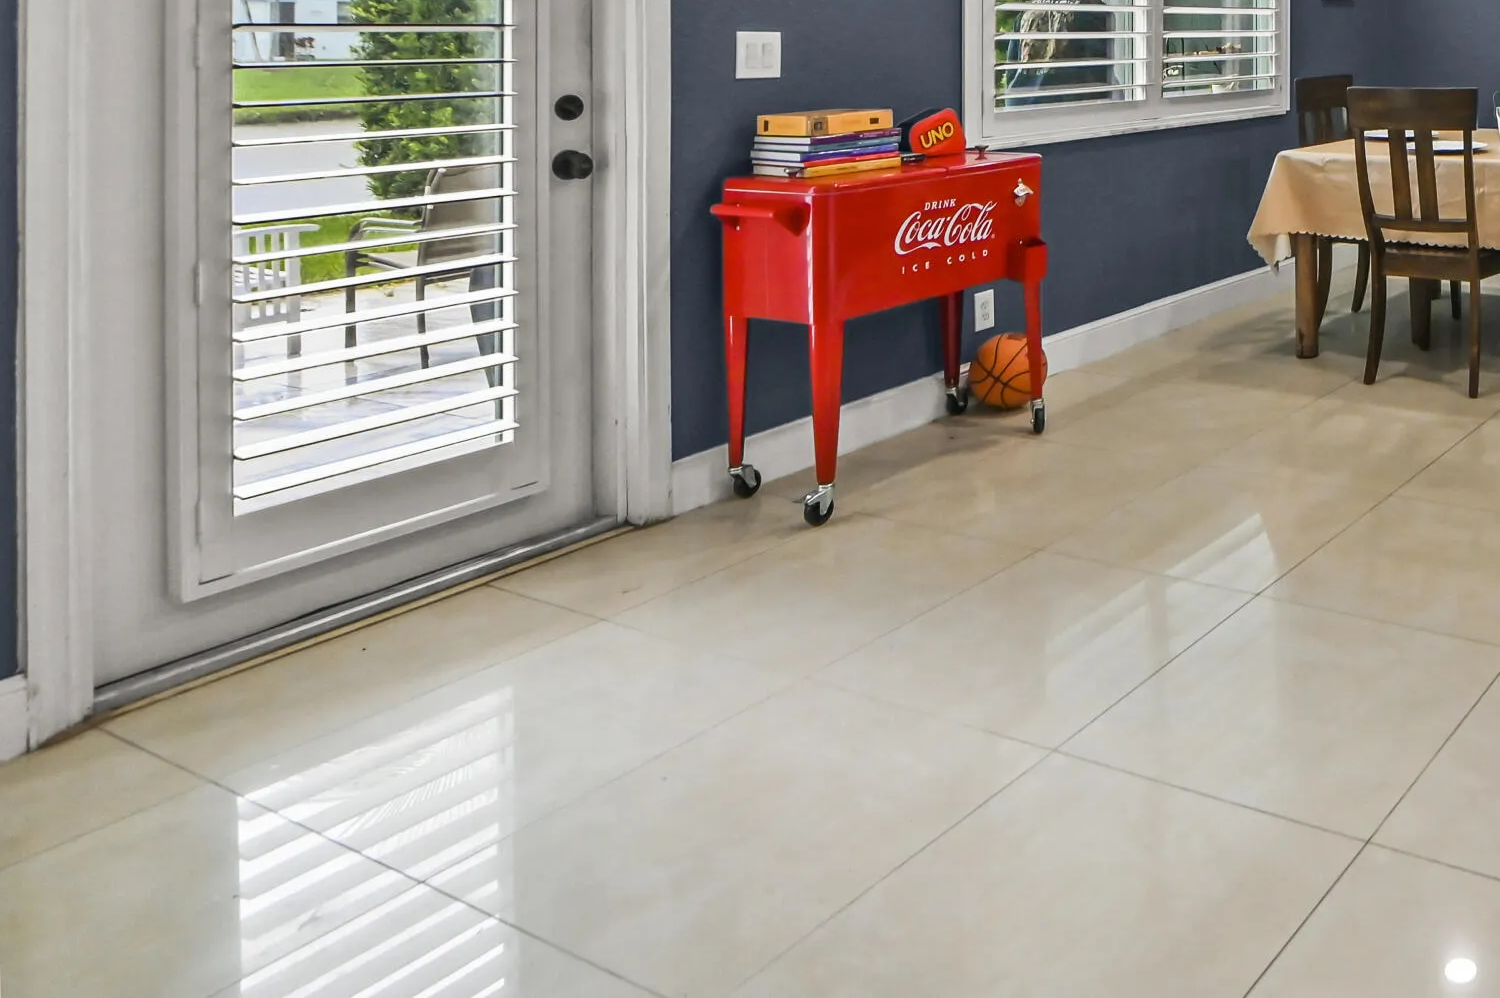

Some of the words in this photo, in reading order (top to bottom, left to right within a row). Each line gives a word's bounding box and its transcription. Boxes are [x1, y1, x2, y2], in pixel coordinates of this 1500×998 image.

[920, 121, 955, 149] UNO
[924, 198, 957, 211] DRINK
[901, 261, 930, 275] ICE
[946, 249, 988, 265] COLD
